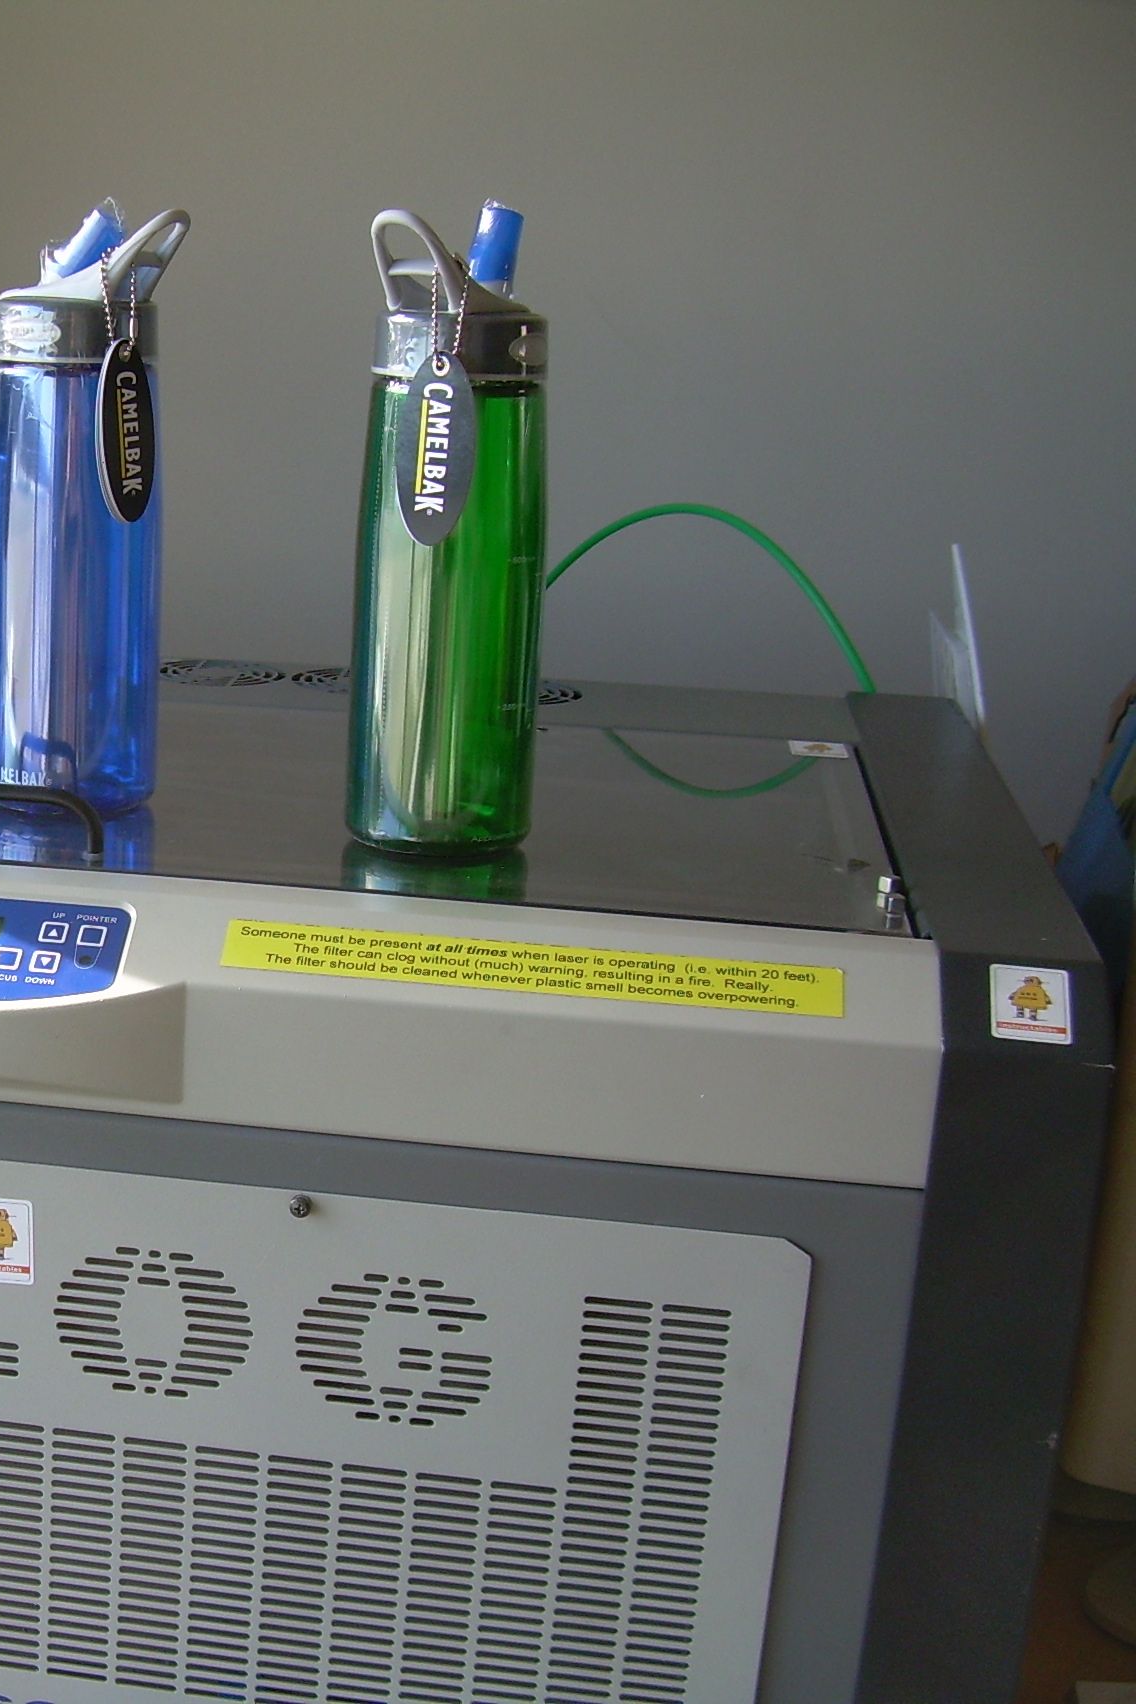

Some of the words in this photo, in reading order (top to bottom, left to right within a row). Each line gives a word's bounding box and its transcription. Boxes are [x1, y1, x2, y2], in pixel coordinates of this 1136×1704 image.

[116, 370, 143, 495] CAMELBAK
[413, 382, 454, 514] CAMELBAK
[52, 911, 66, 919] UP
[76, 913, 118, 924] POINTER
[24, 976, 55, 986] DOWN
[240, 926, 306, 941] Someone
[310, 934, 344, 944] must
[348, 934, 366, 946] be
[370, 938, 422, 951] present
[426, 943, 442, 952] at
[444, 944, 463, 955] all
[466, 945, 508, 958] times
[511, 949, 550, 961] when
[554, 952, 590, 964] laser
[593, 955, 604, 966] is
[608, 958, 675, 973] operating
[715, 966, 757, 978] within
[761, 969, 780, 980] 20
[784, 970, 820, 984] feet).
[265, 952, 292, 964] The
[295, 955, 325, 968] filter
[329, 959, 376, 972] should
[380, 963, 398, 974] be
[401, 965, 458, 979] cleaned
[461, 970, 532, 985] whenever
[535, 974, 582, 989] plastic
[585, 979, 624, 993] smell
[627, 982, 694, 999] becomes
[697, 990, 800, 1009] overpowering.
[293, 943, 319, 955] The
[323, 944, 354, 957] filter
[357, 950, 383, 960] can
[386, 951, 416, 964] clog
[419, 953, 470, 967] without
[474, 958, 524, 973] (much)
[592, 969, 653, 984] resulting
[658, 973, 671, 984] in
[675, 976, 684, 985] a
[688, 975, 715, 987] fire.
[724, 978, 773, 993] Really.
